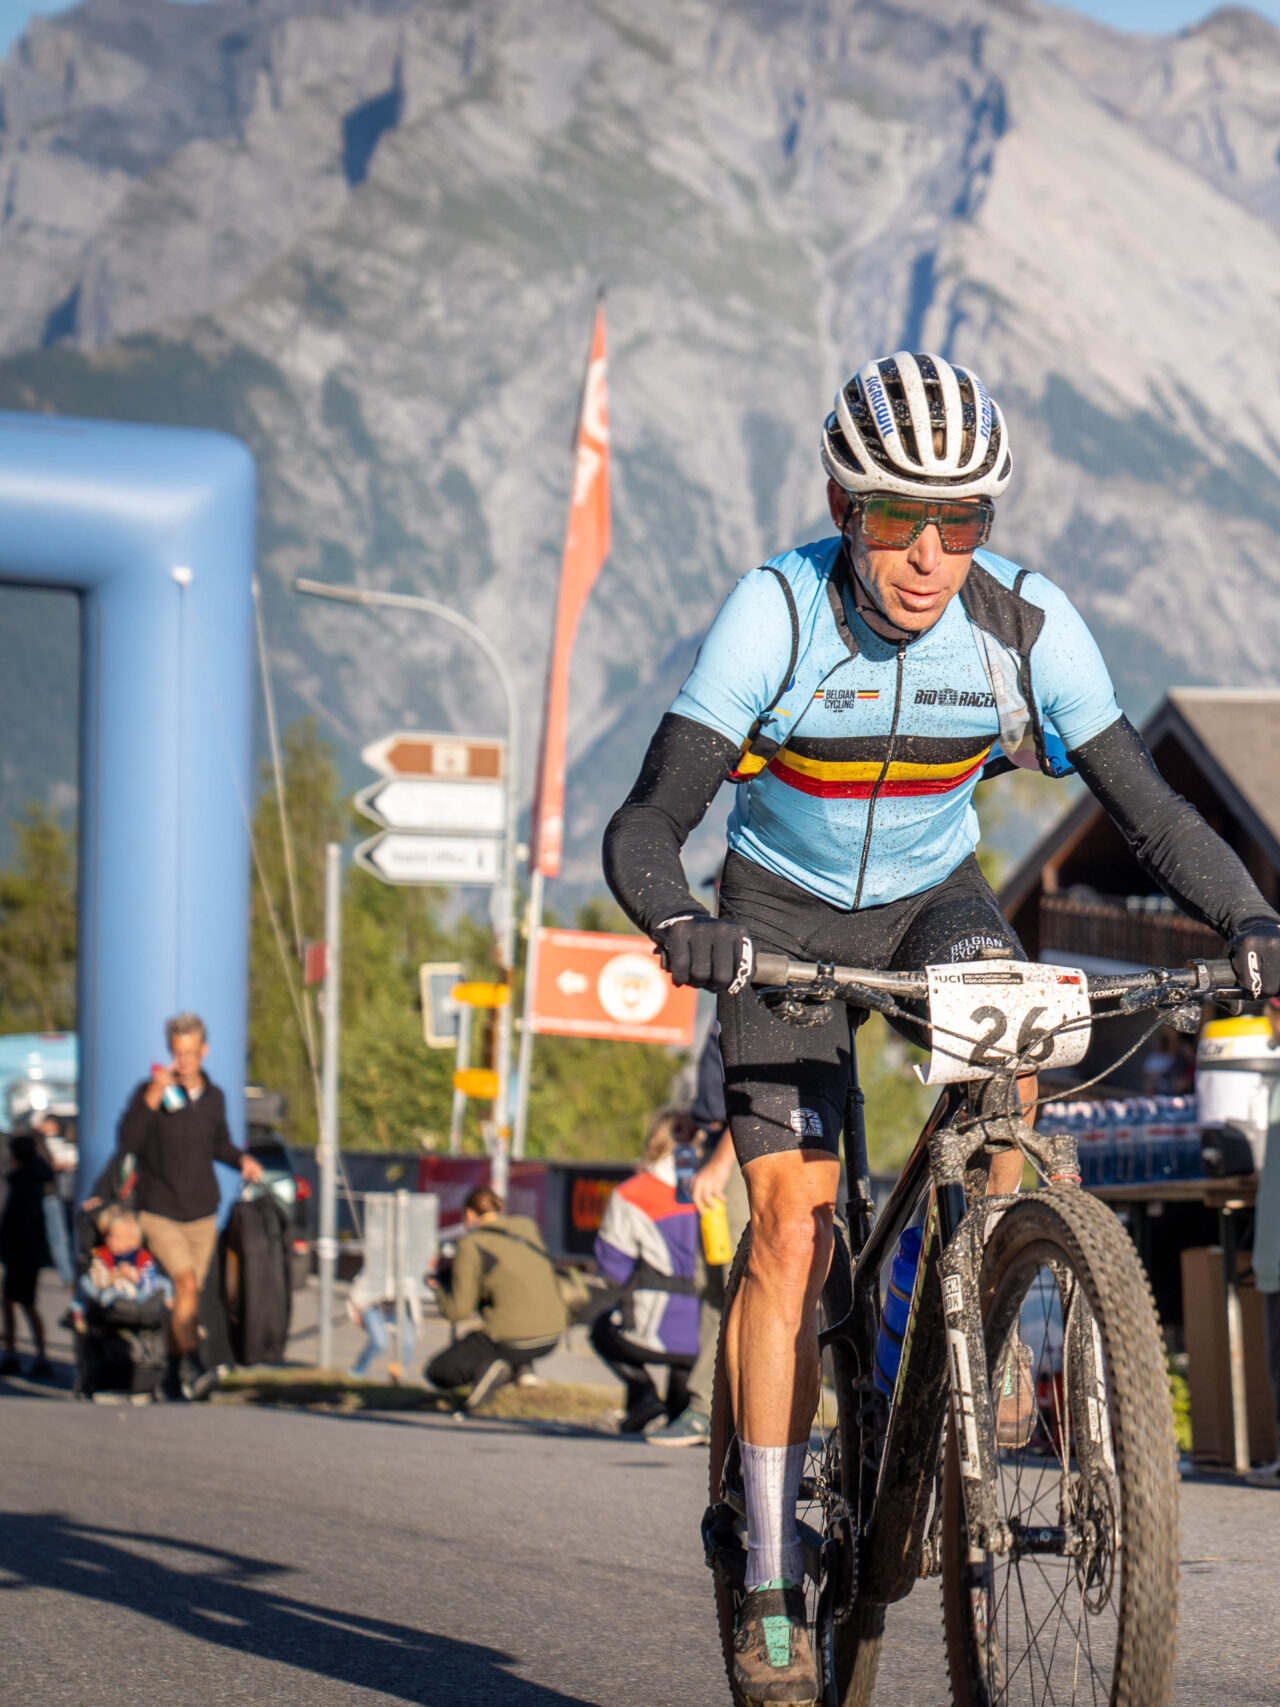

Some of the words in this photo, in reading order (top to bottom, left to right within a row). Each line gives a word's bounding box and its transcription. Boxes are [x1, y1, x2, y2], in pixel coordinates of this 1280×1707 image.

[866, 376, 895, 438] SIGRISWIL
[826, 689, 855, 699] BELGIAN
[914, 689, 938, 705] BIO
[824, 699, 854, 709] CYCLING
[951, 936, 1003, 954] BELGIAN
[939, 975, 960, 983] UCI
[1093, 988, 1129, 998] CONCEPT
[968, 1005, 1055, 1067] 26
